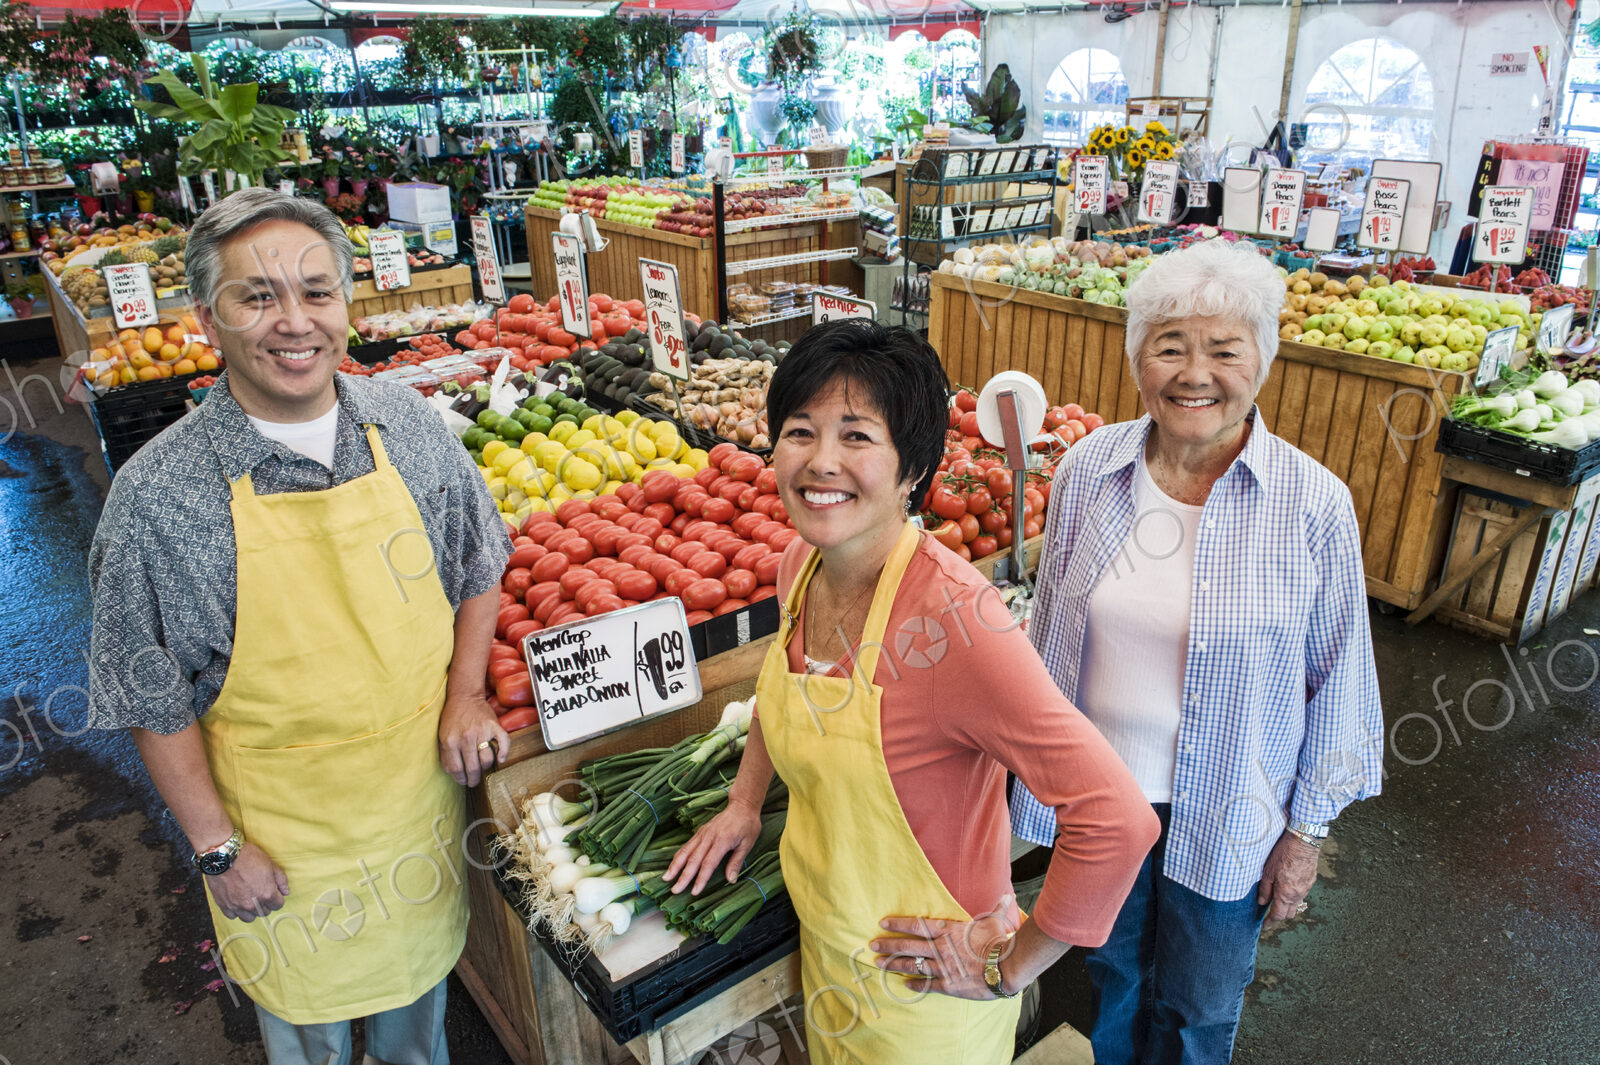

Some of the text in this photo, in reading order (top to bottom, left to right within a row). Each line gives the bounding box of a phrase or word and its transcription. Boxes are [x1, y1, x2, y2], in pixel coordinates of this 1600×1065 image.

[1502, 53, 1514, 62] NO
[1491, 64, 1527, 74] SMOKING
[1275, 190, 1294, 200] Pears
[1375, 189, 1398, 199] Bosc
[1373, 199, 1398, 210] Pears
[1489, 196, 1521, 207] Bartlett
[1492, 207, 1517, 217] Pears
[646, 263, 666, 281] Jumbo
[820, 295, 836, 310] Red
[651, 310, 663, 345] 3
[561, 630, 592, 649] Crop
[542, 681, 631, 719] SALAD ONION
